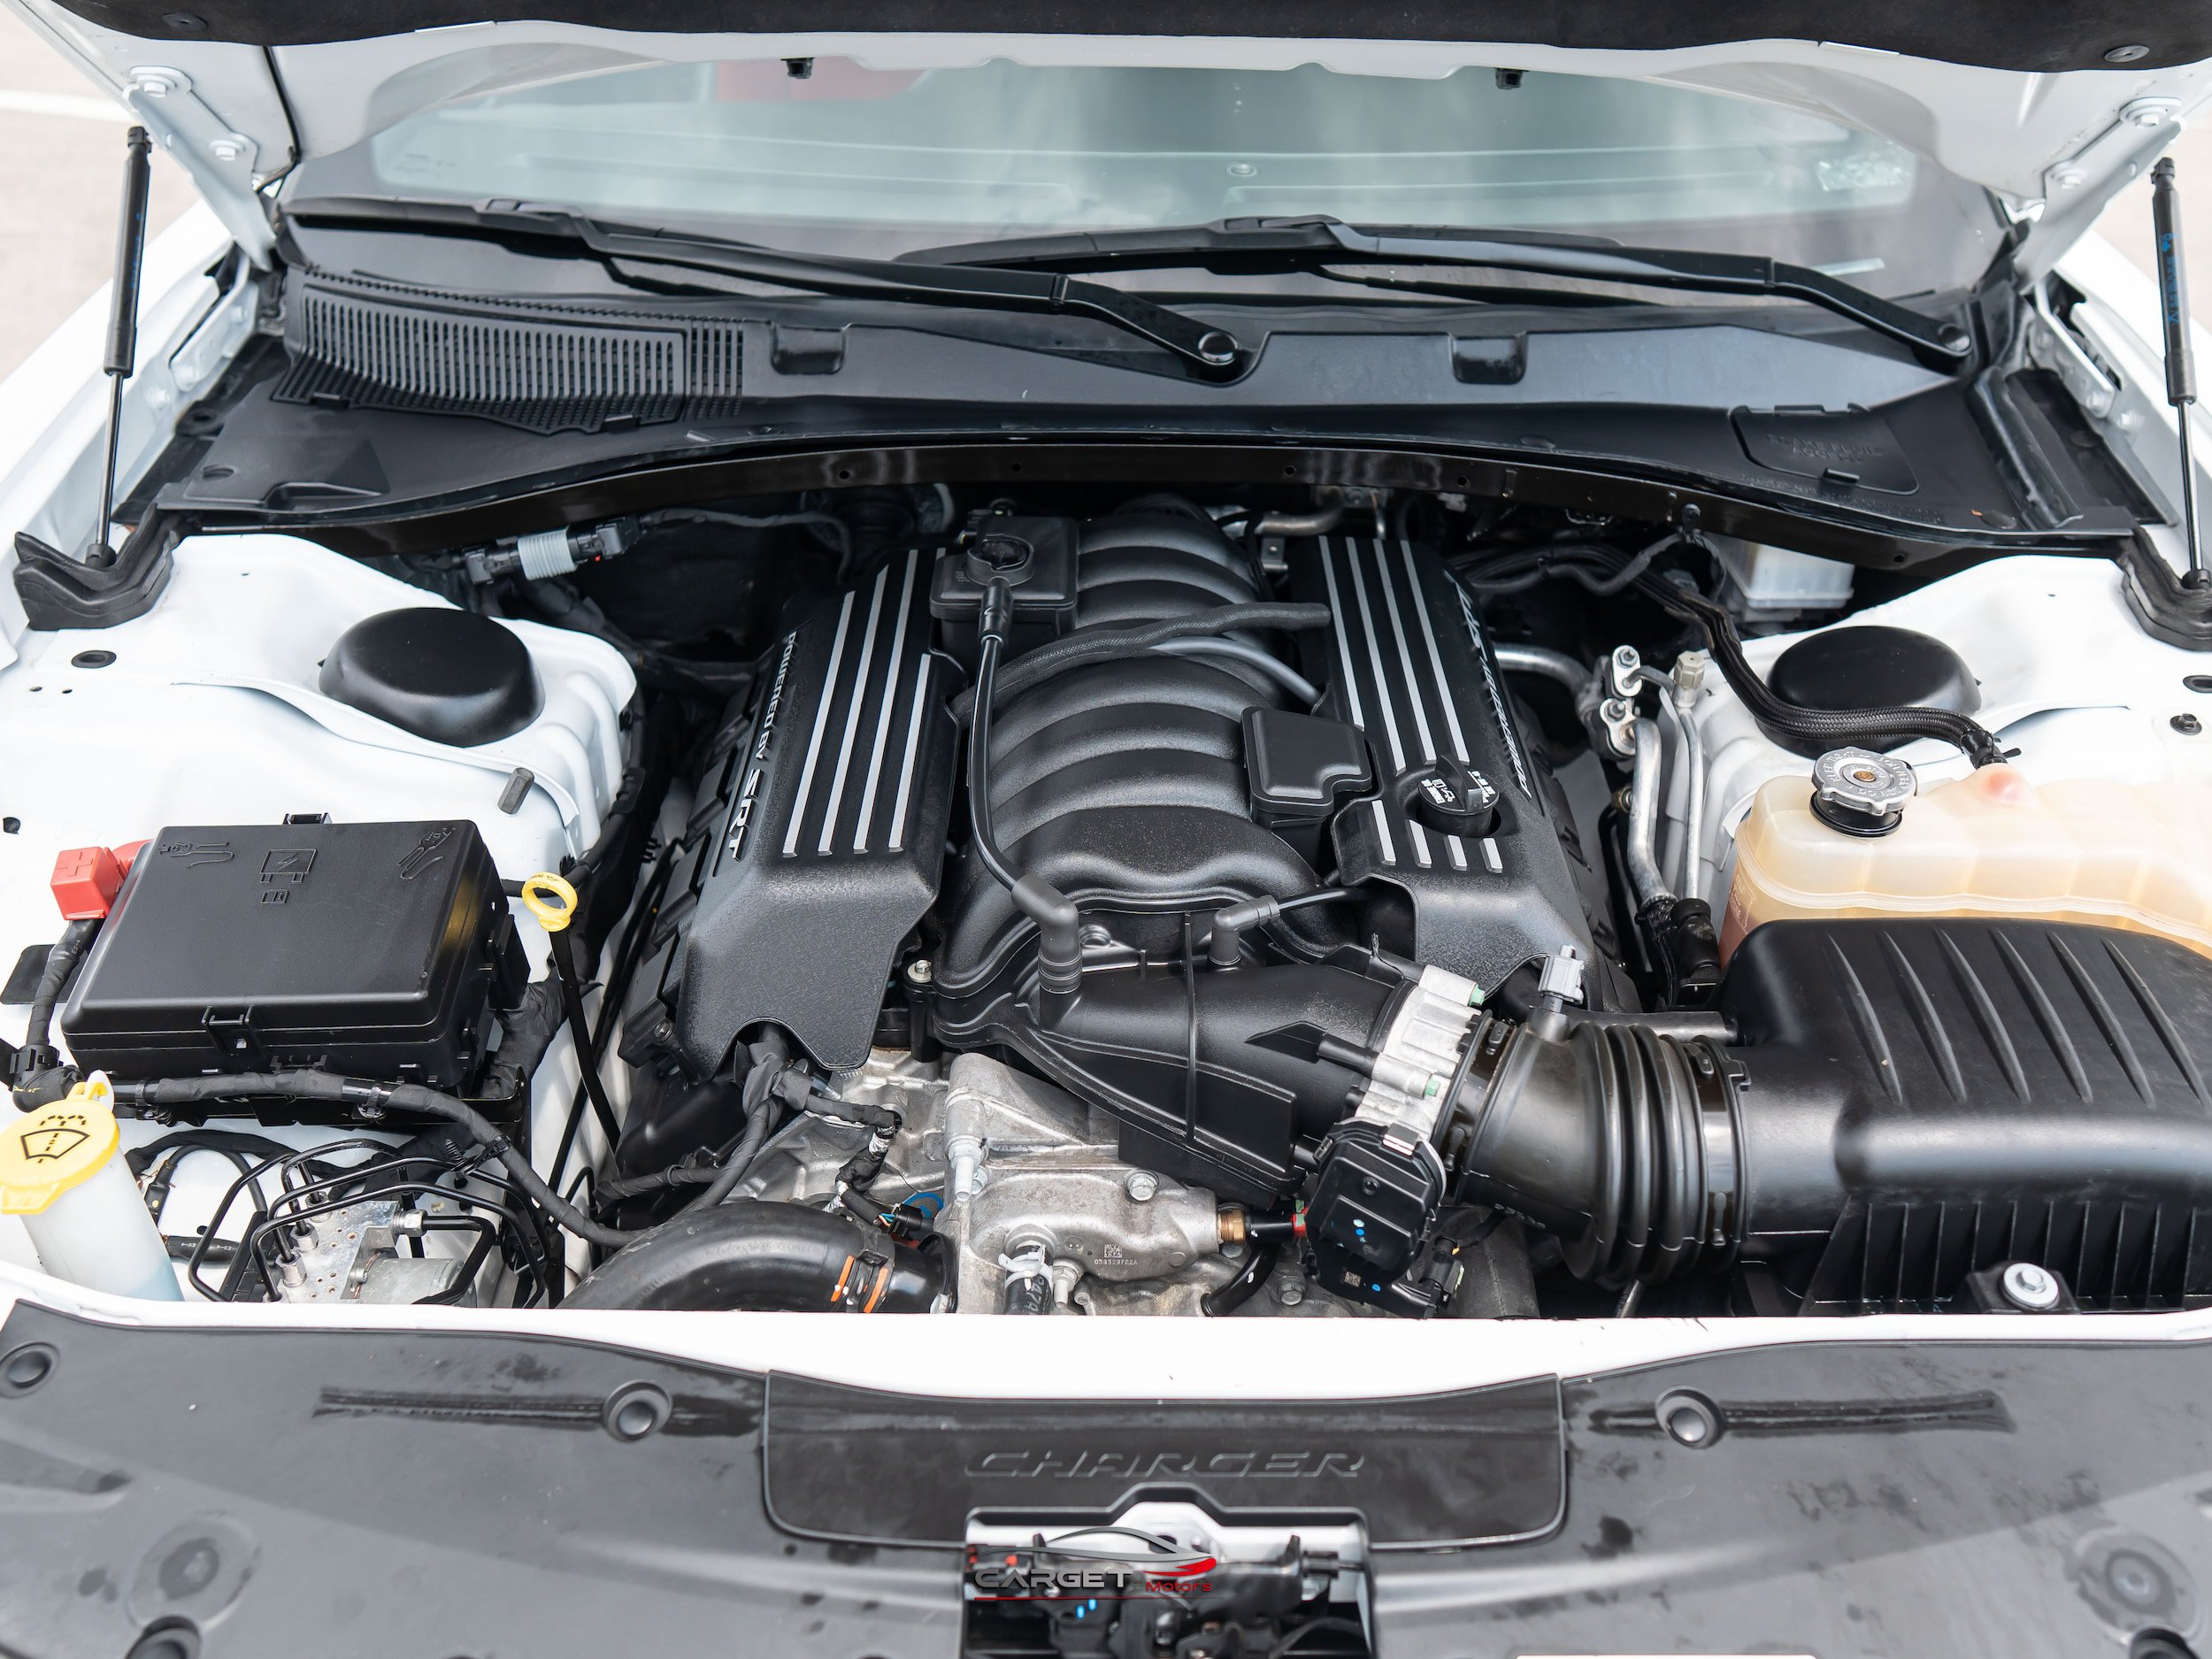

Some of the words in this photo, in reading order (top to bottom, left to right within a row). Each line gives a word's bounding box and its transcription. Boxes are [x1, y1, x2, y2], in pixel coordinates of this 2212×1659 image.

[764, 631, 797, 729] POWERED
[756, 730, 770, 759] BY
[729, 768, 761, 861] SRT
[964, 1450, 1365, 1479] CHARGER
